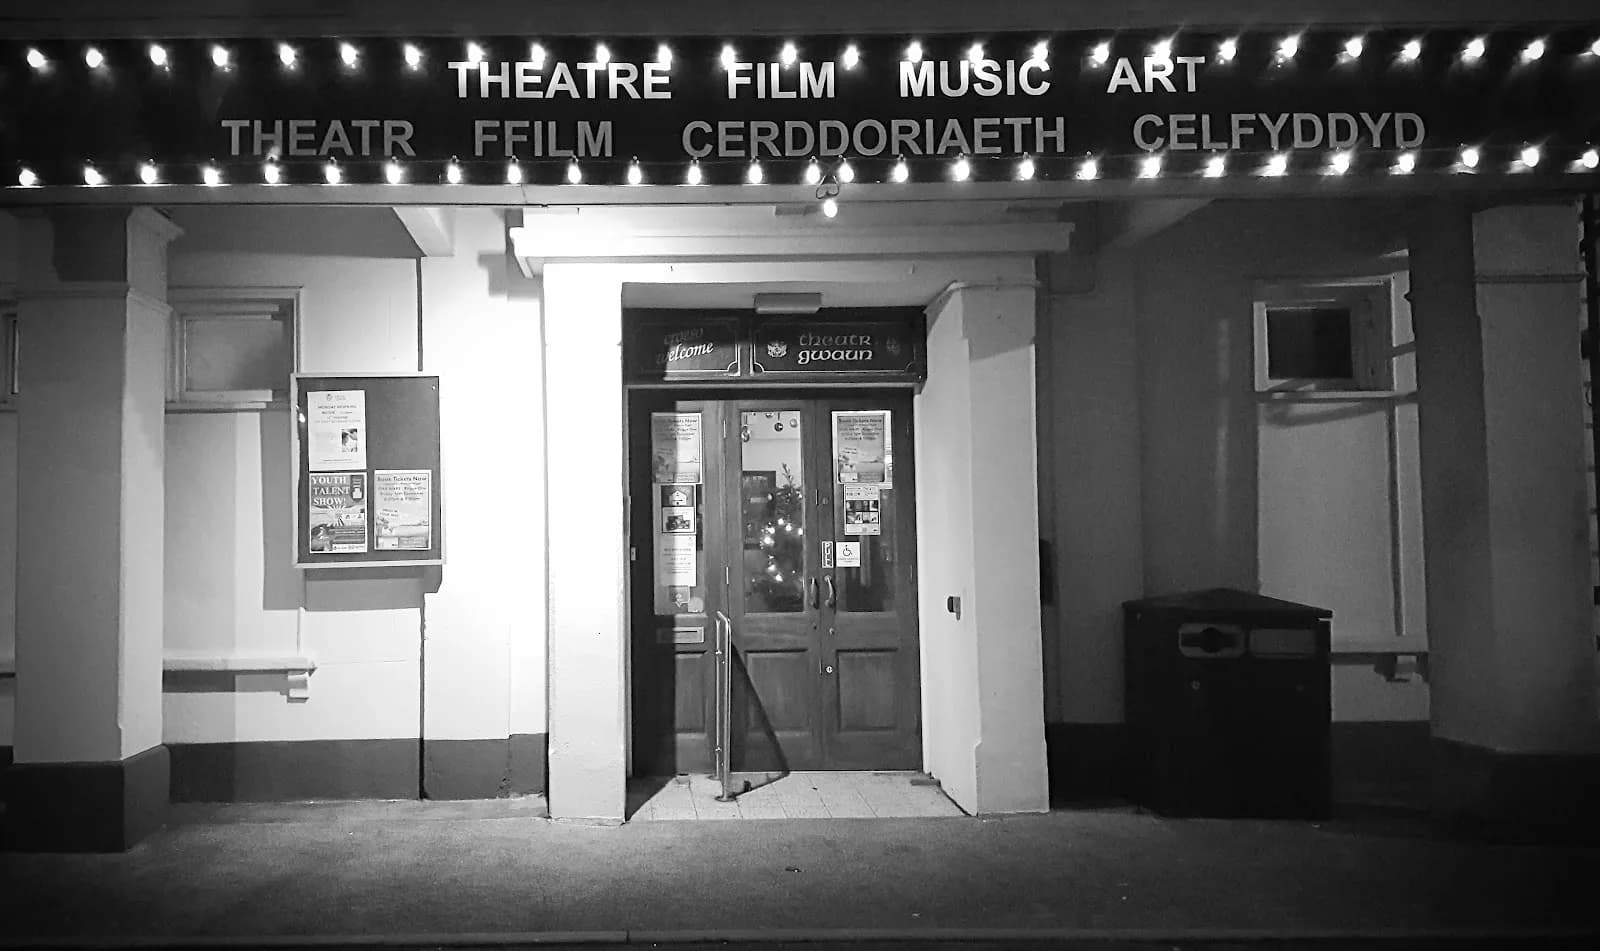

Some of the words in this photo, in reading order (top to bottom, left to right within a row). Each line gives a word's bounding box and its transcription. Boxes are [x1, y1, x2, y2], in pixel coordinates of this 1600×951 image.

[447, 61, 673, 99] THEATRE
[726, 61, 836, 100] FILM
[899, 58, 1051, 97] MUSIC
[1106, 55, 1206, 94] ART
[221, 119, 417, 157] THEATR
[473, 120, 613, 158] FFILM
[681, 116, 1065, 158] CERDDORIAETH
[1132, 112, 1425, 151] CELFYDDYD
[656, 342, 714, 364] welcome
[797, 349, 873, 366] gwaun
[311, 476, 347, 485] YOUTH
[313, 486, 351, 496] TALENT
[313, 497, 346, 506] SHOW!
